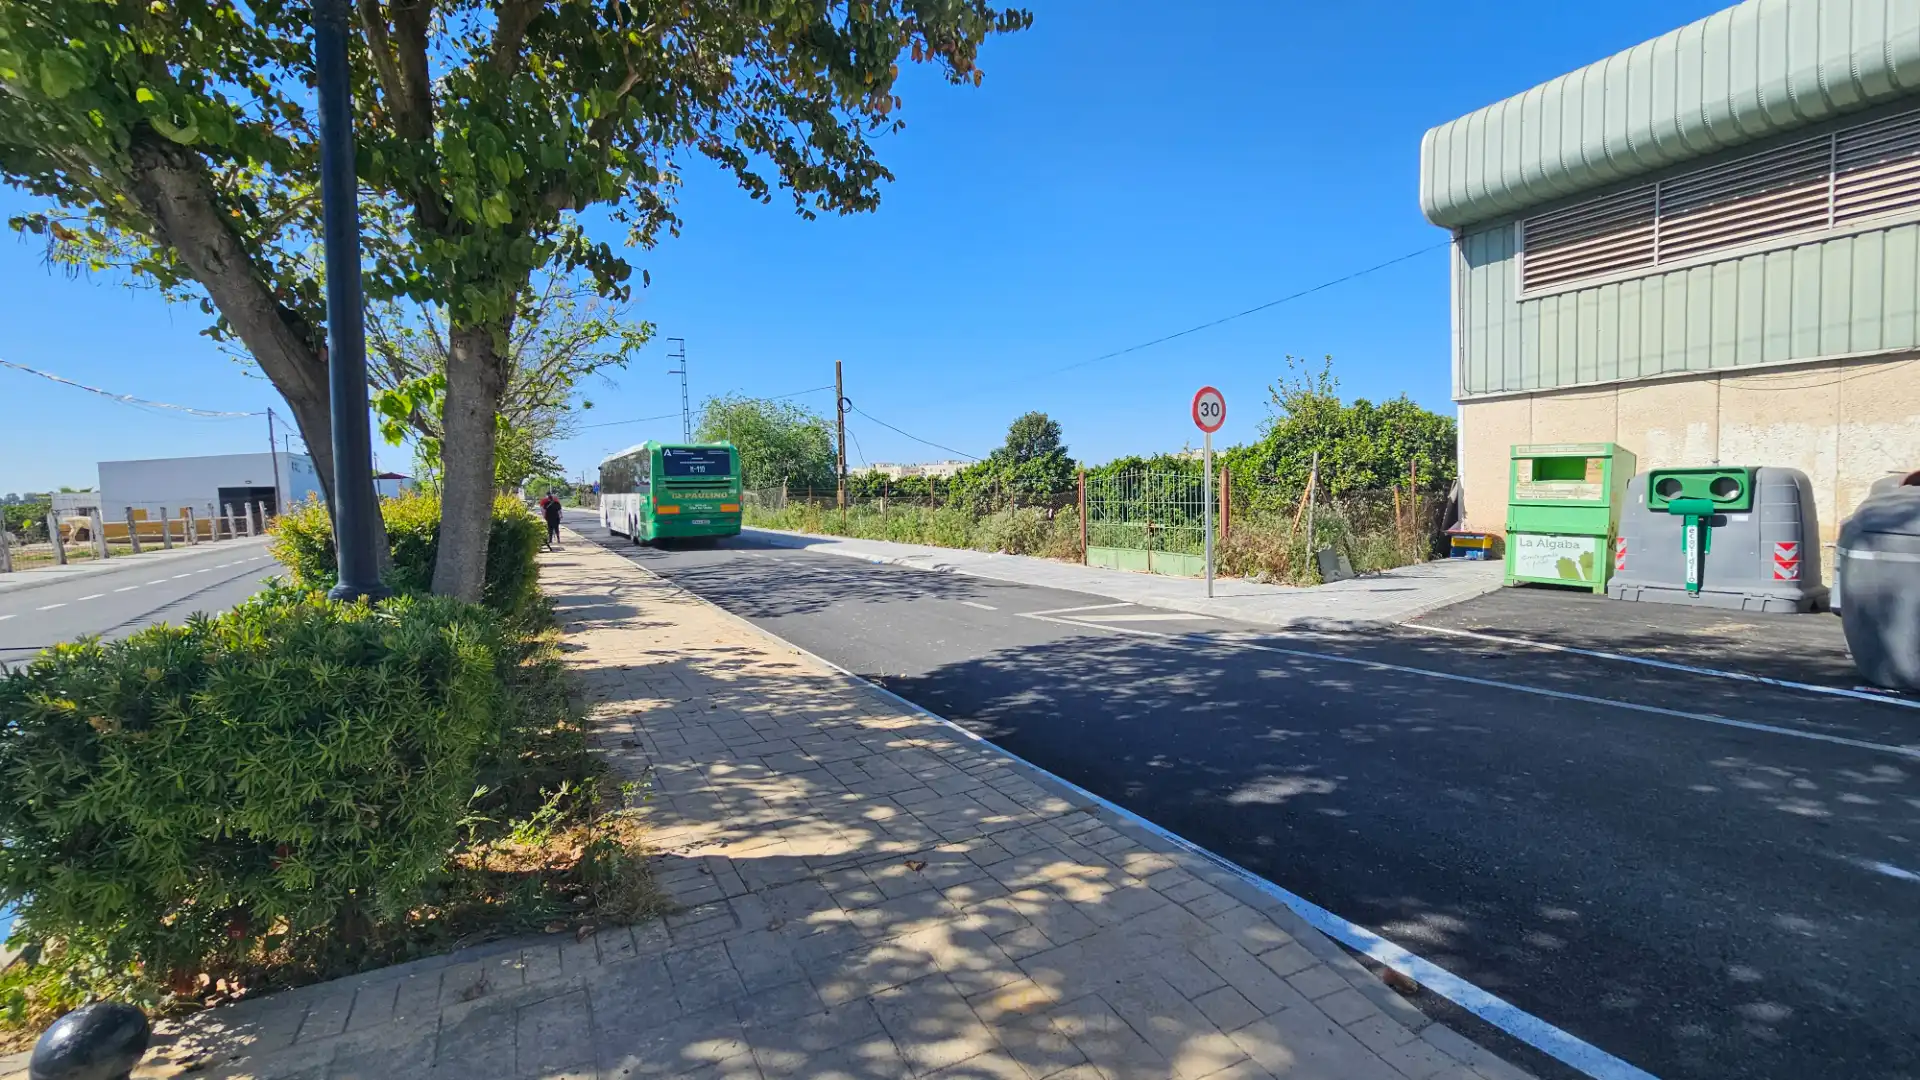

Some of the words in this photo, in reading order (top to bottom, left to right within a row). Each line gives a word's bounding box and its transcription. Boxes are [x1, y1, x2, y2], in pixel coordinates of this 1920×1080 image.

[1200, 401, 1220, 417] 30
[1519, 537, 1533, 547] La
[1536, 539, 1581, 550] Algaba
